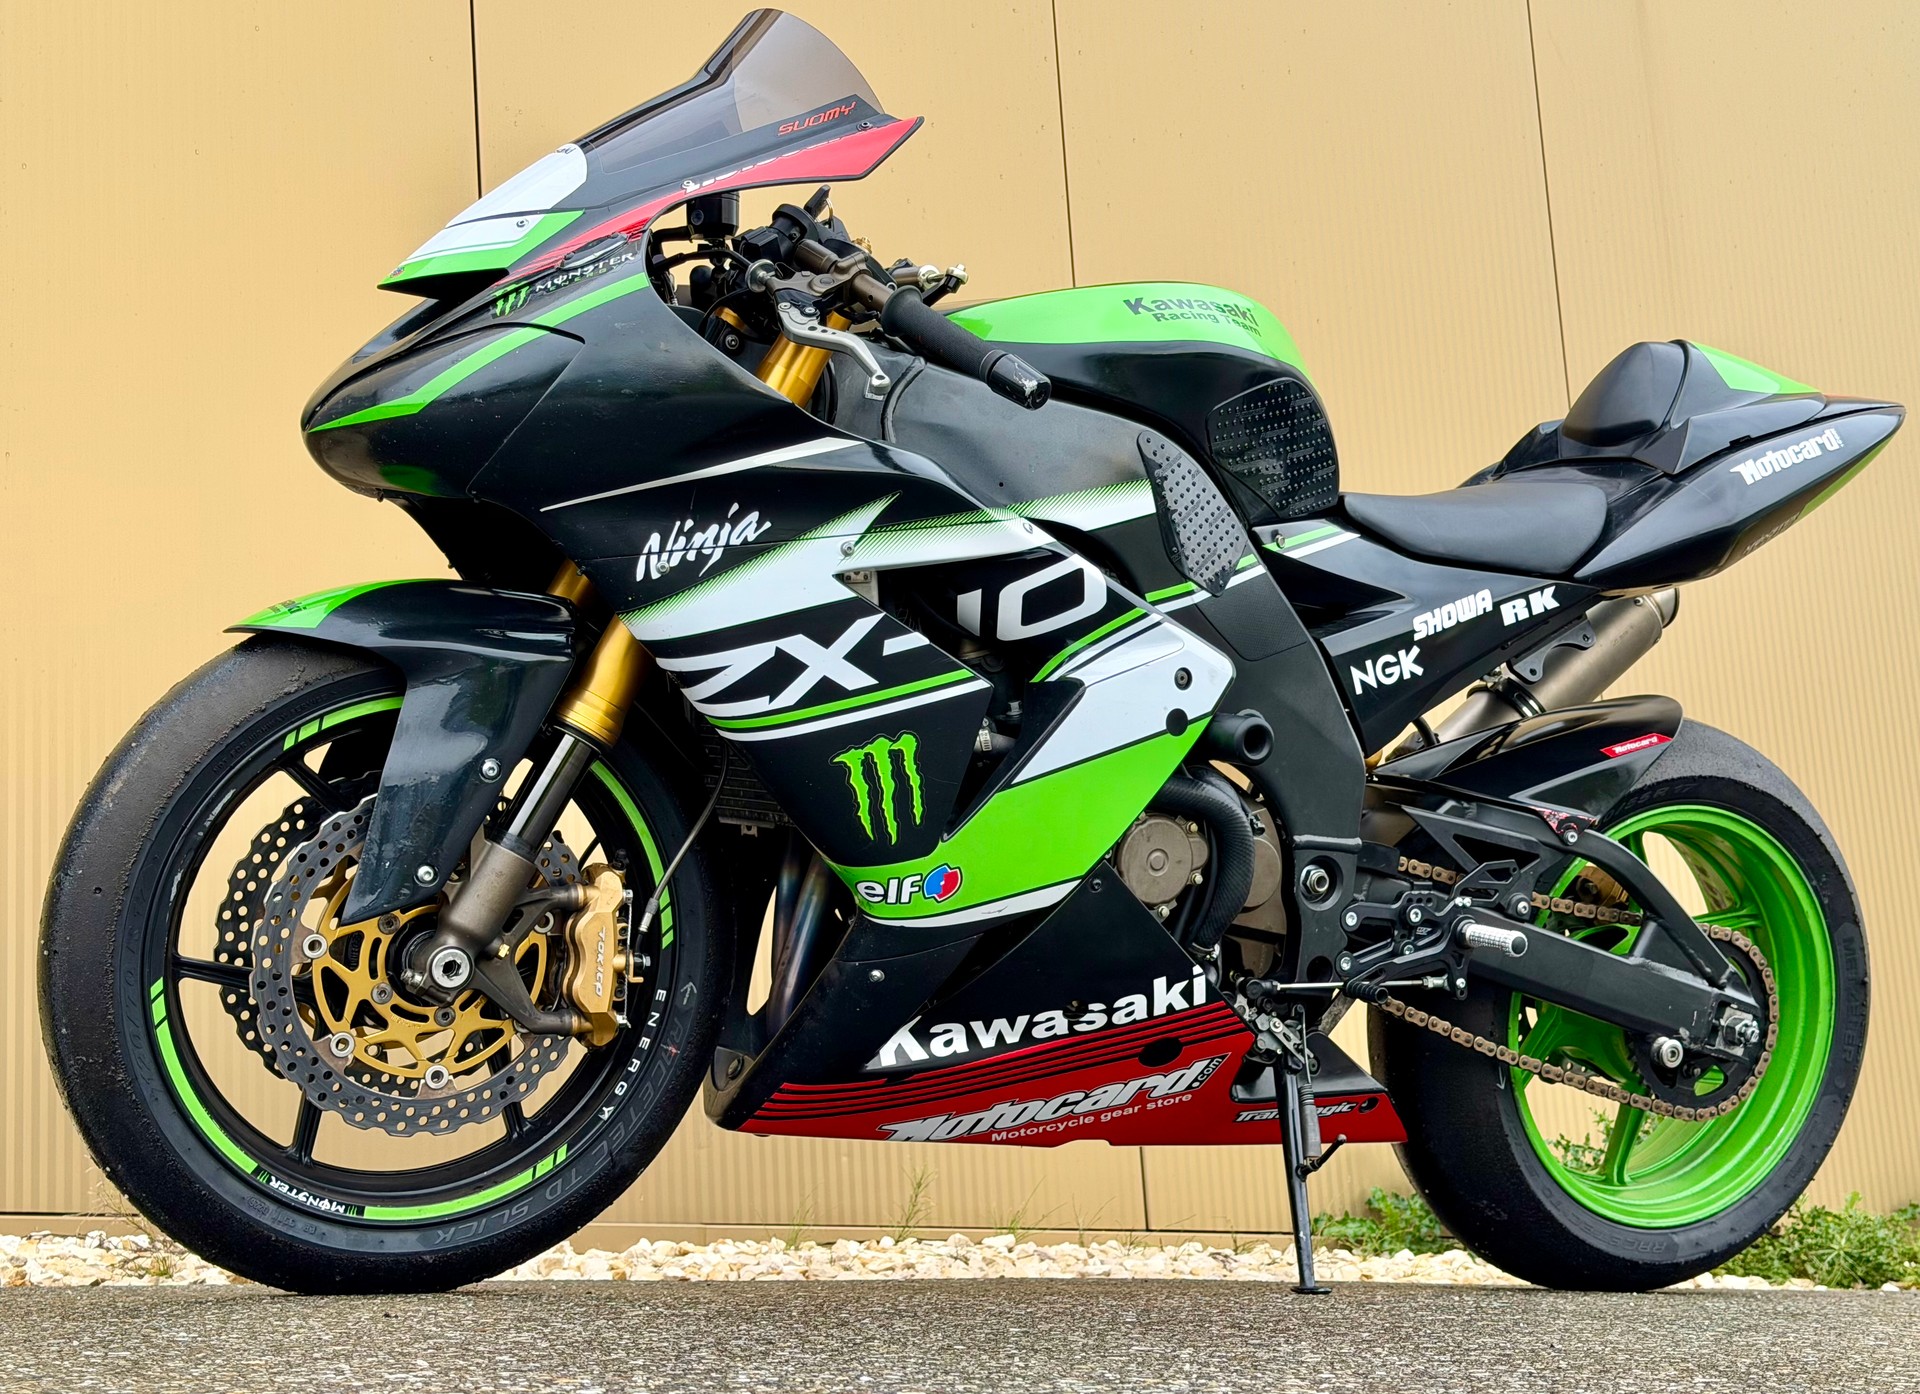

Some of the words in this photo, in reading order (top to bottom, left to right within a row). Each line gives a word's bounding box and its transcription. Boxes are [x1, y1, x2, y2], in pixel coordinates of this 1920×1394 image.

[777, 101, 857, 137] SUOMY
[549, 265, 619, 291] ENERGY
[1123, 297, 1260, 327] Kawasaki
[1151, 311, 1220, 324] Racing
[1220, 313, 1262, 337] Team
[636, 502, 772, 582] Ninja
[1412, 588, 1494, 642] SHOWA
[1500, 585, 1561, 626] RK
[1350, 645, 1424, 695] NGK
[1611, 735, 1658, 754] Motocard
[856, 874, 923, 905] elf
[592, 926, 606, 998] TOKICO
[879, 964, 1207, 1067] Kawasaki
[598, 988, 667, 1122] ENERGY
[992, 1115, 1095, 1143] Motorcycle
[1100, 1103, 1141, 1123] gear
[1146, 1094, 1193, 1112] store
[269, 1175, 346, 1214] MONSTER
[434, 1197, 534, 1245] SLICK
